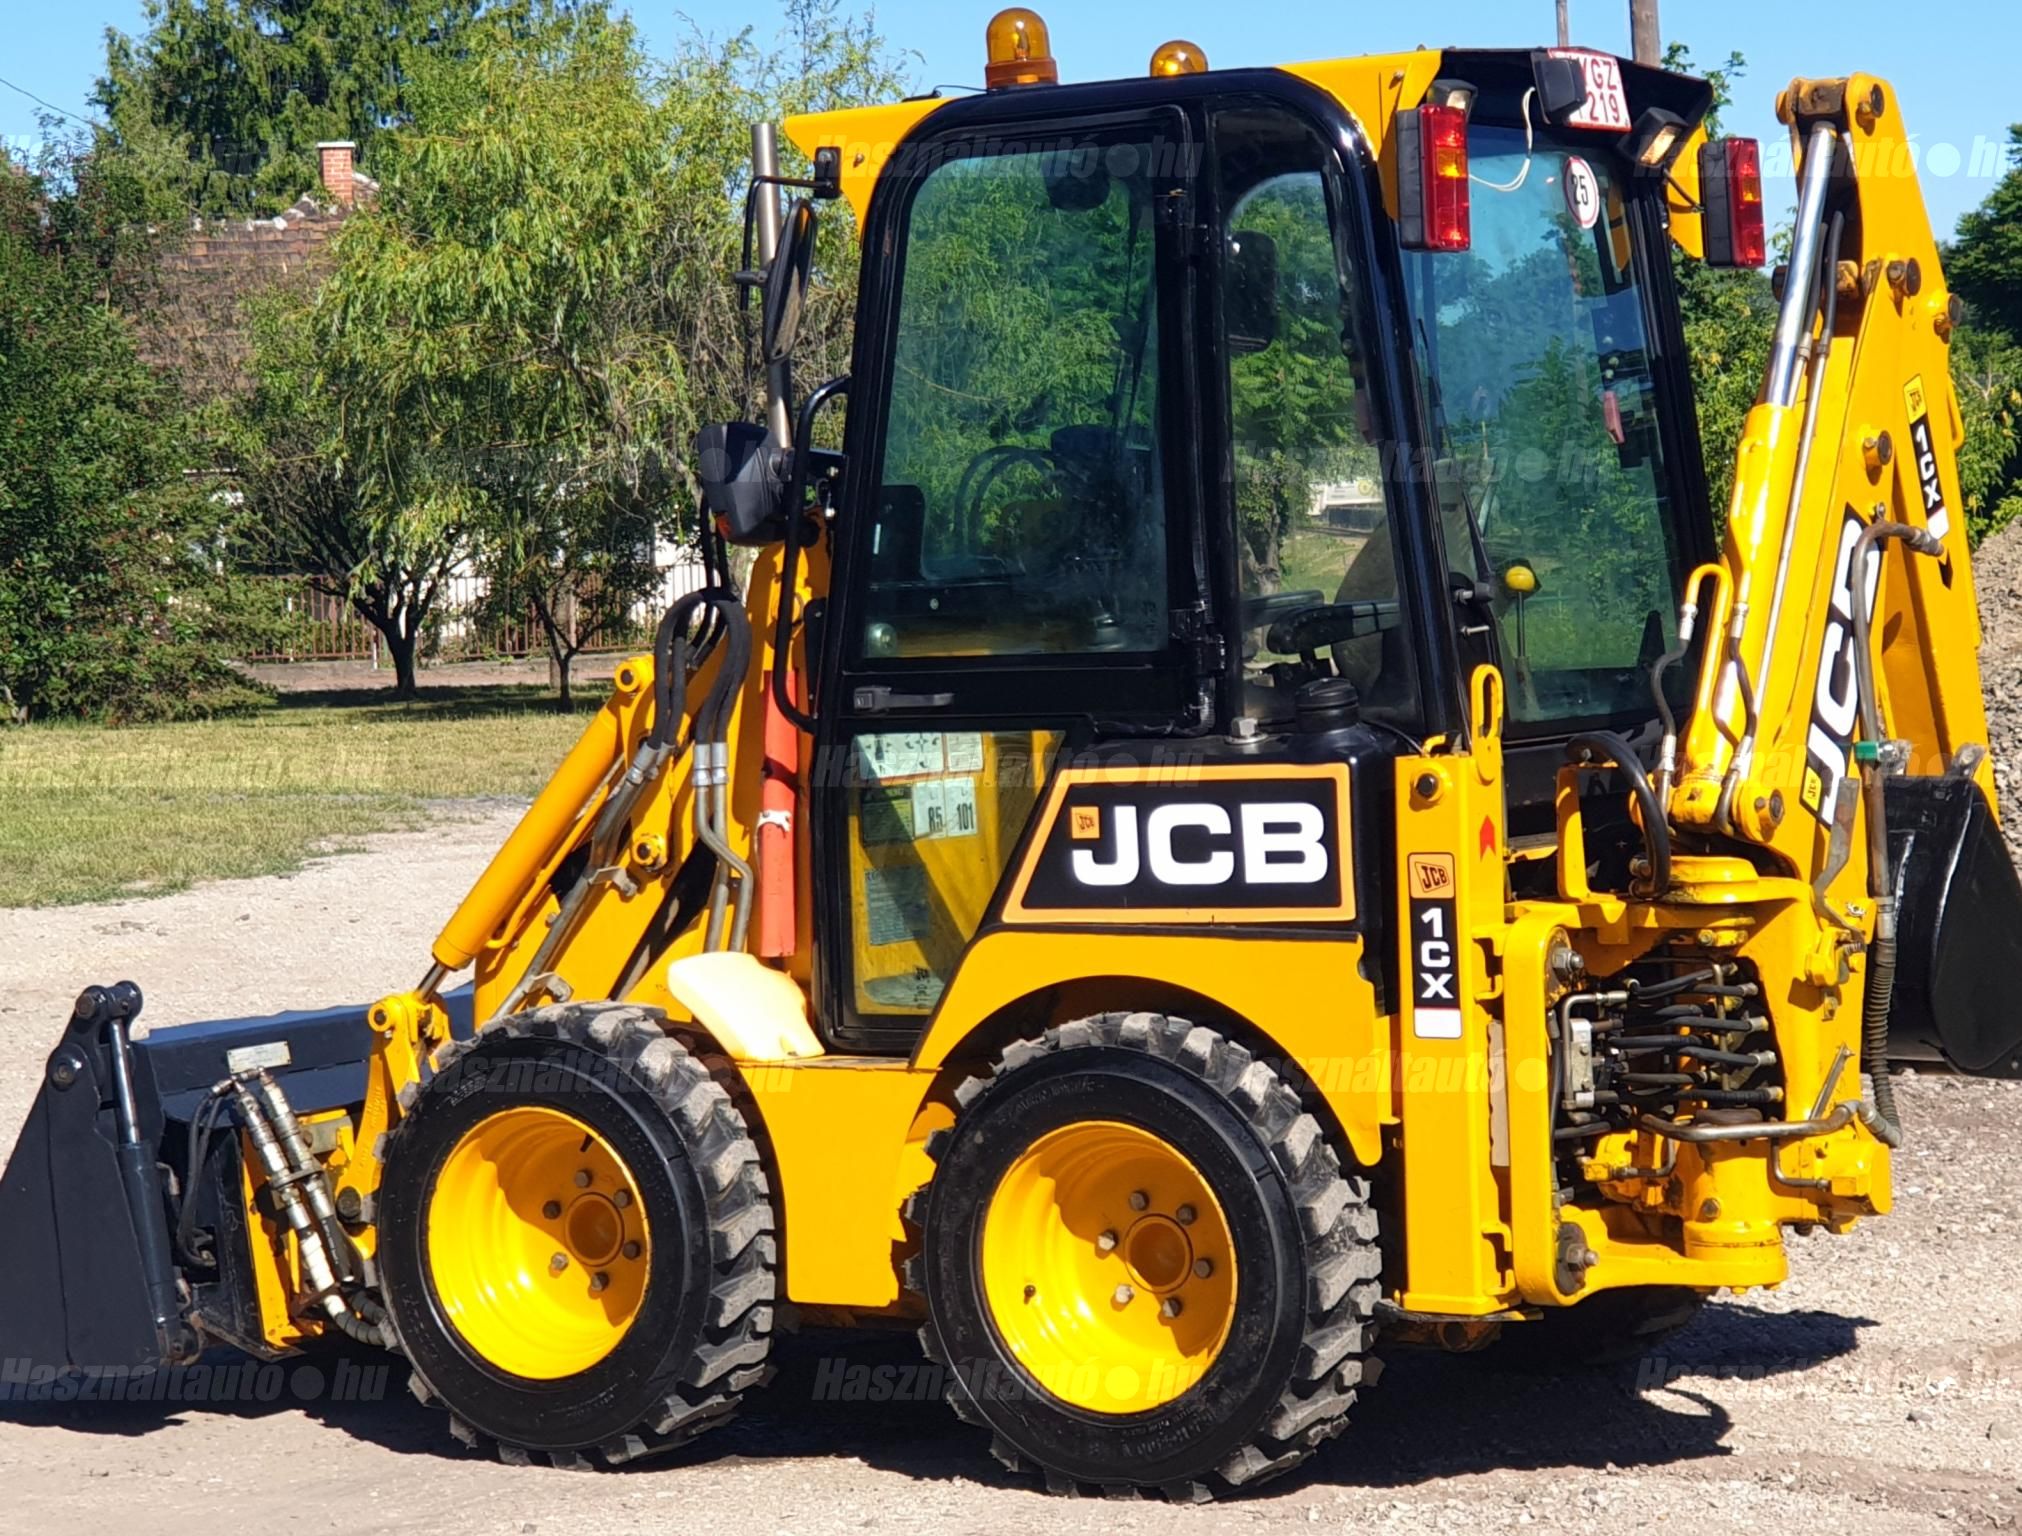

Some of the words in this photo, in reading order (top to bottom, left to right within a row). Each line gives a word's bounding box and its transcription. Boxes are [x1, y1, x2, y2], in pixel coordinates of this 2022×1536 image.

[1571, 174, 1589, 206] 25
[1916, 424, 1942, 509] 1CX
[1807, 518, 1880, 826] JCB
[956, 802, 974, 832] 101
[1072, 802, 1328, 886] JCB
[1421, 865, 1448, 889] JCB
[1420, 907, 1454, 999] 1CX
